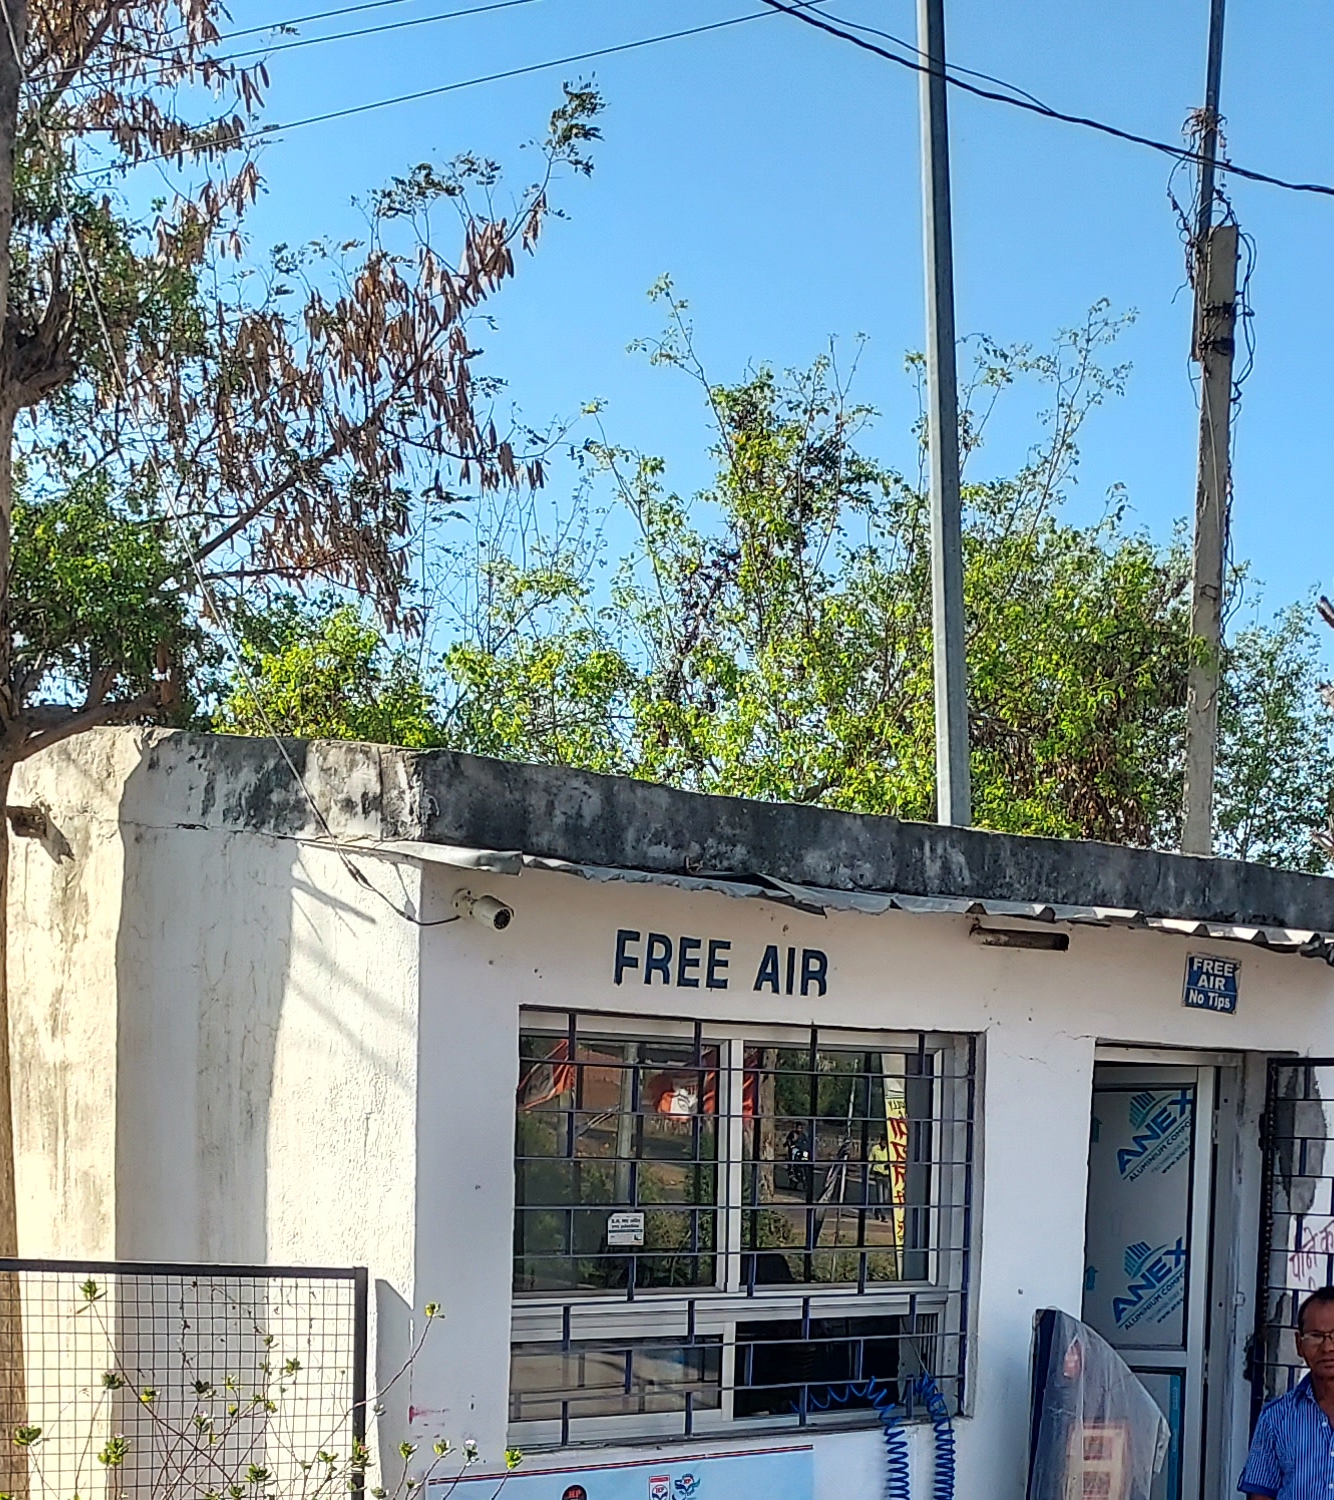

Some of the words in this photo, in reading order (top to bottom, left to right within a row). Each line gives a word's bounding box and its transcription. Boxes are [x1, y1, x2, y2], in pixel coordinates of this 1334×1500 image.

[613, 928, 733, 989] FREE
[753, 944, 829, 997] AIR
[1193, 957, 1234, 977] FREE
[1188, 989, 1204, 1004] No
[1208, 992, 1231, 1010] Tips
[1197, 974, 1226, 991] AIR
[1117, 1088, 1194, 1175] ANEX
[1129, 1144, 1167, 1182] ALUMINIUM
[1112, 1236, 1186, 1324] ANEX
[1124, 1294, 1162, 1331] ALUMINIUM
